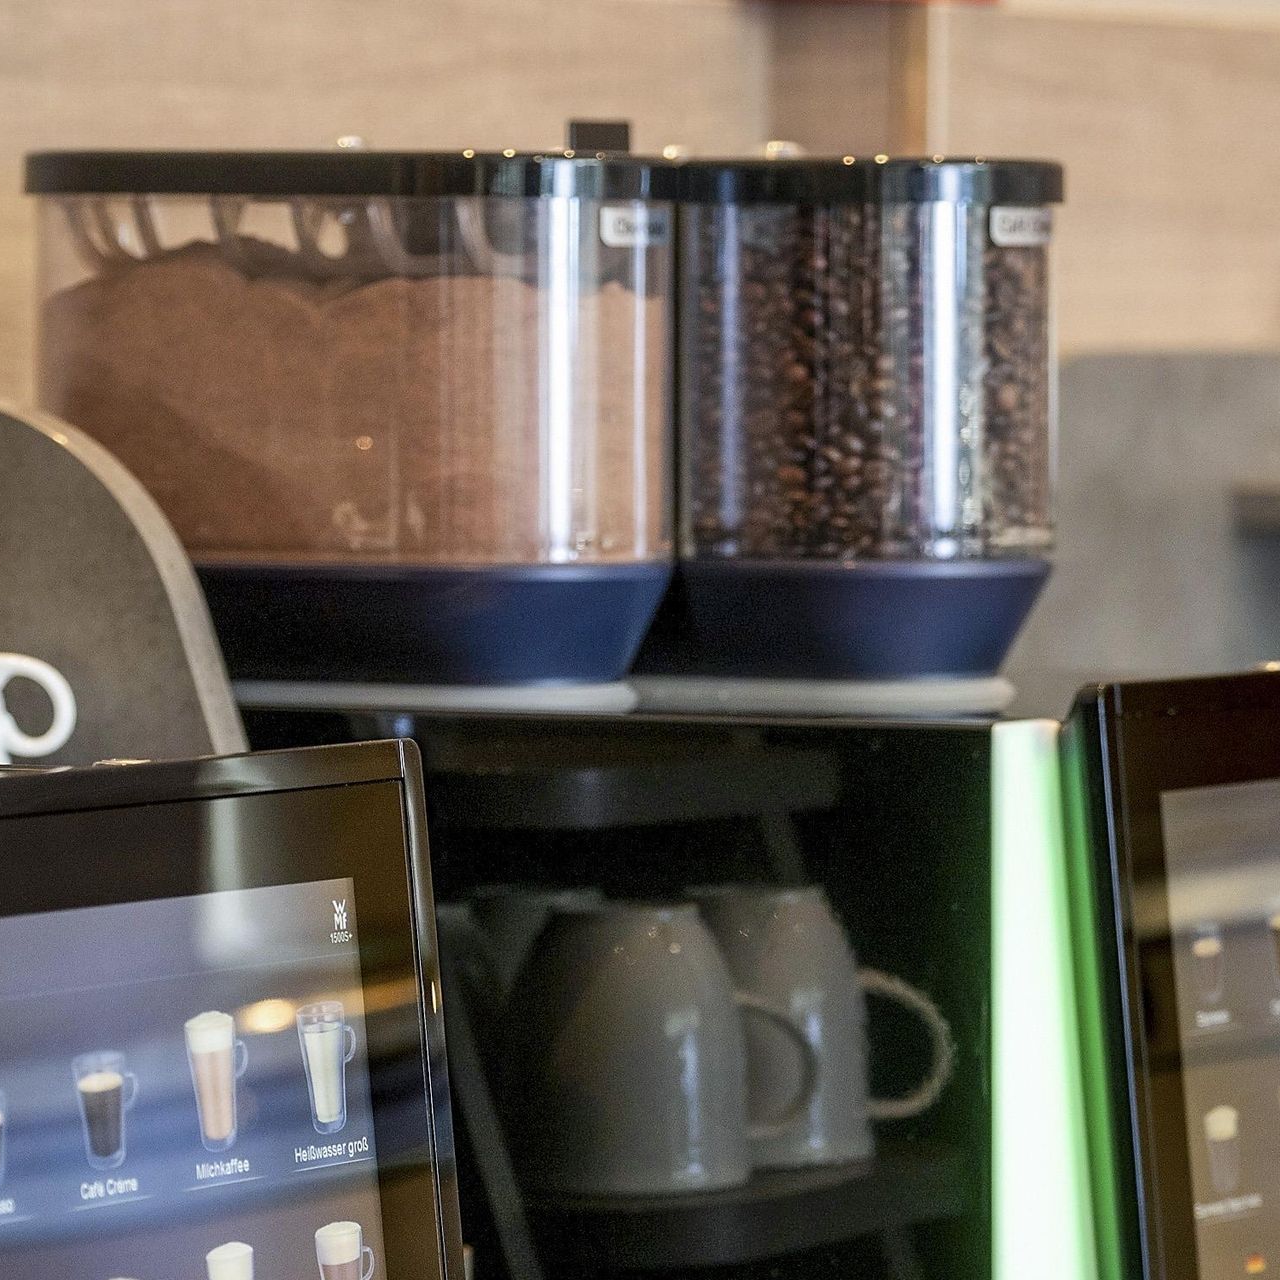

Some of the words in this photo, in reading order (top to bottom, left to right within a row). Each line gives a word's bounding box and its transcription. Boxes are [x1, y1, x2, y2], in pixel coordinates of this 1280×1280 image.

[294, 1143, 347, 1163] Heißwasser
[347, 1136, 369, 1158] groß
[196, 1158, 250, 1180] Milchkaffee
